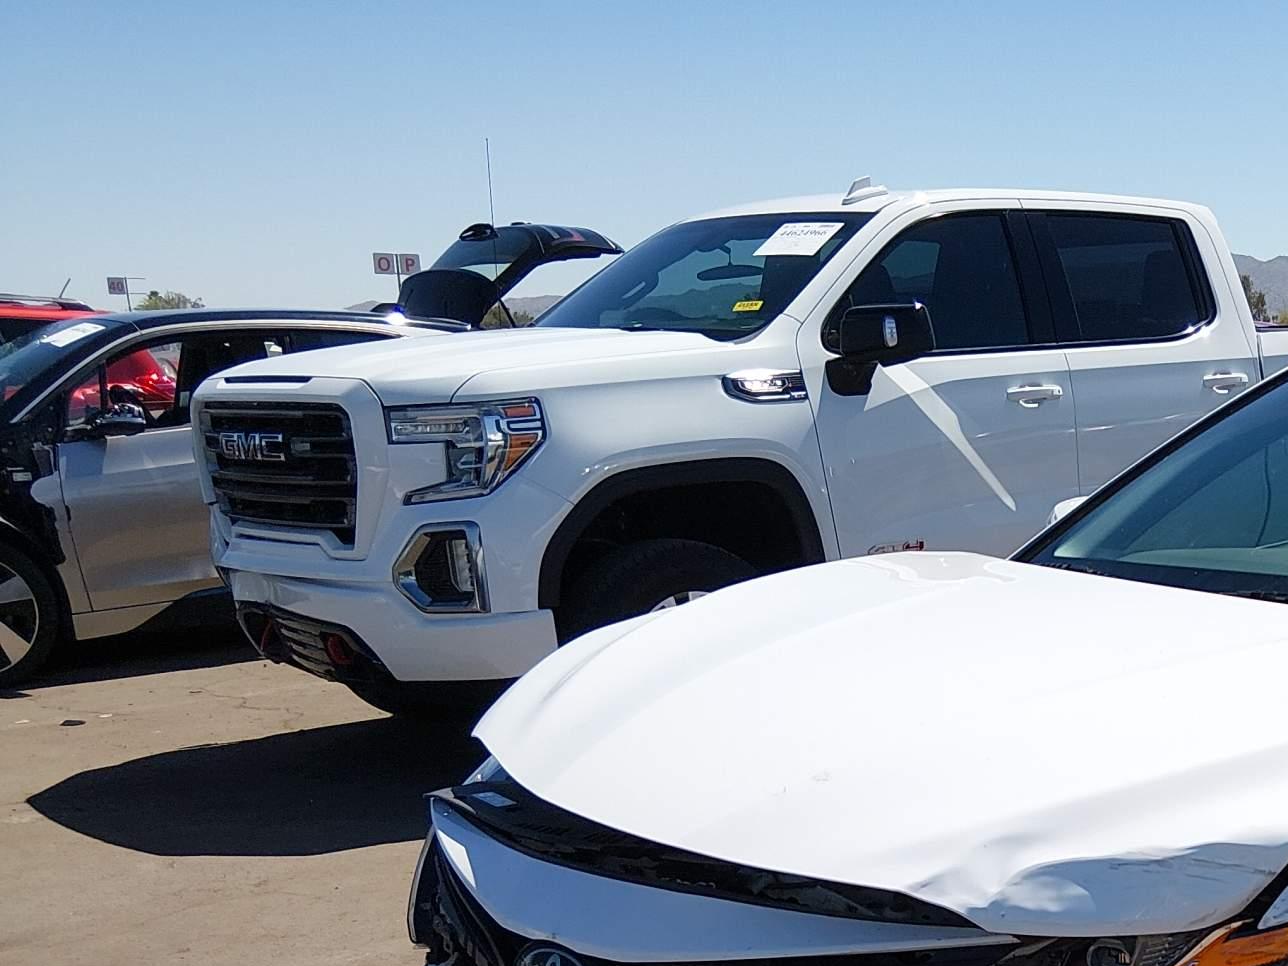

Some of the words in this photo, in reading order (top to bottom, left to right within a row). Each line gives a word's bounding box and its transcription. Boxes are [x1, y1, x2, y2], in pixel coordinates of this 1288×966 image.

[377, 256, 391, 272] O
[405, 256, 416, 272] P
[219, 432, 286, 461] GMC
